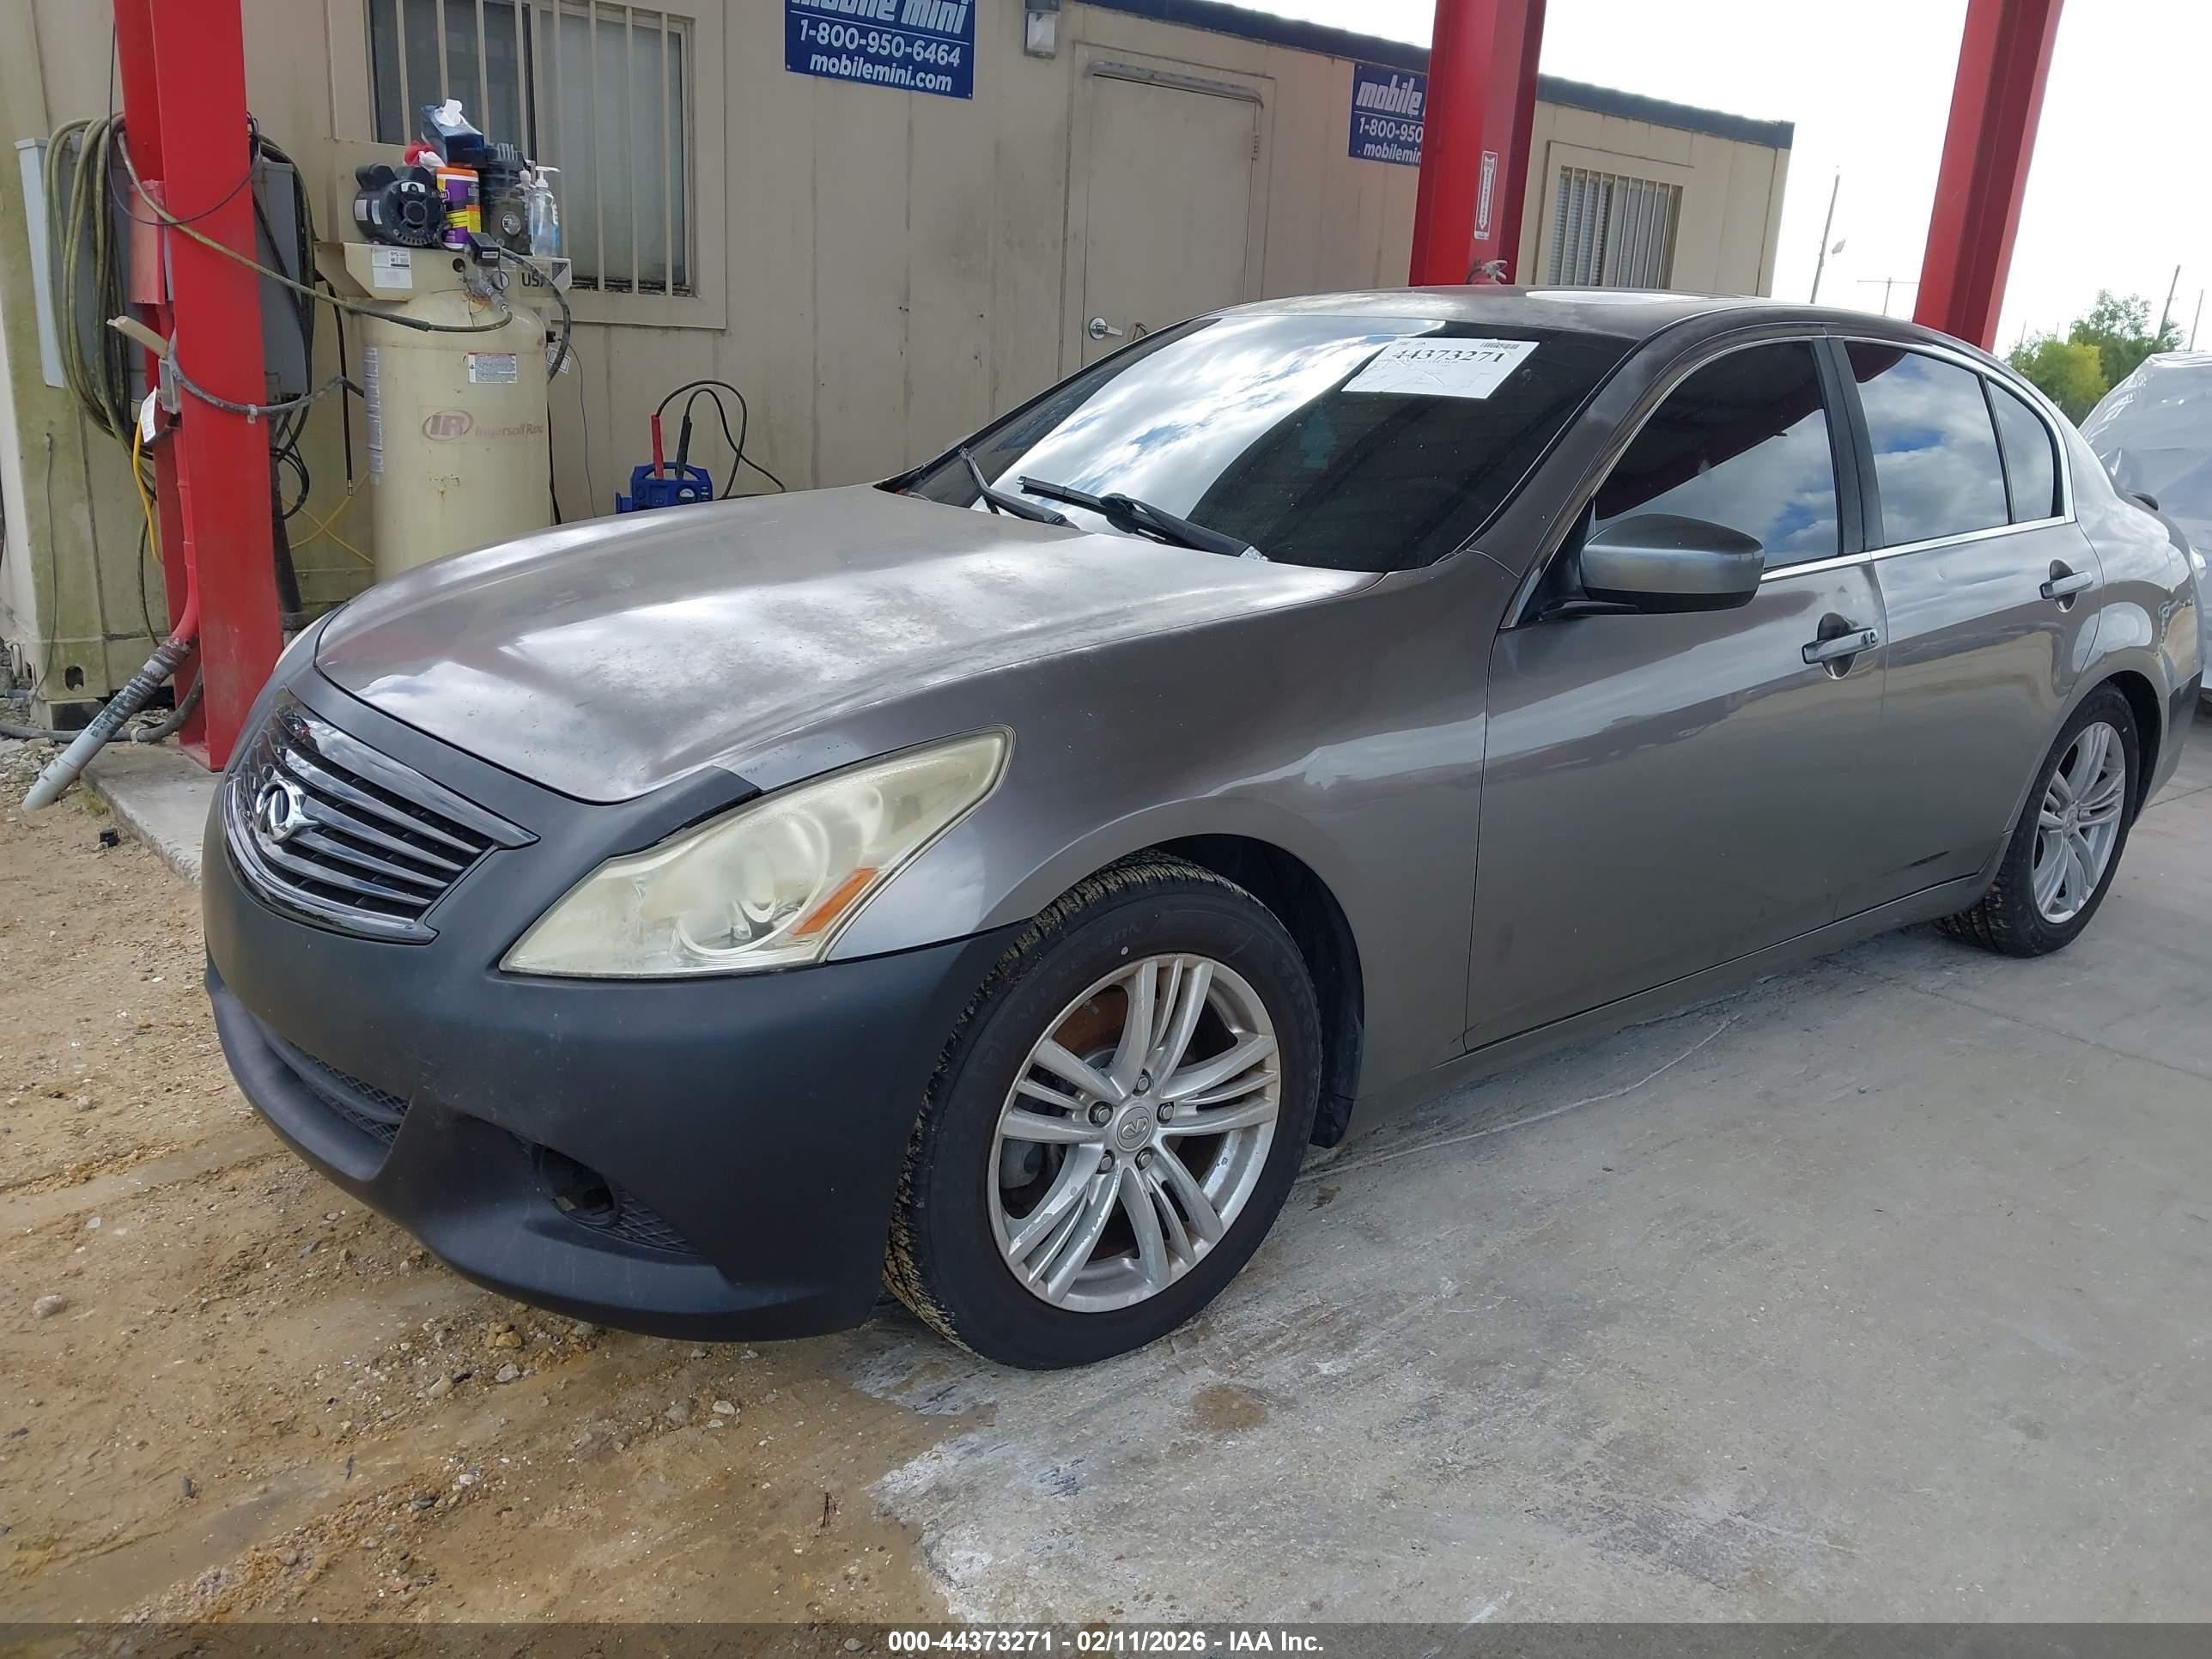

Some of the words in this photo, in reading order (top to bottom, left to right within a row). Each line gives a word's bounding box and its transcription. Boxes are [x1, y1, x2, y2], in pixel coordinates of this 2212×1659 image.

[799, 19, 962, 68] 1-800-950-6464
[809, 53, 952, 92] mobilemini.com
[1356, 75, 1422, 116] mobile
[1359, 117, 1423, 143] 1-800-950
[521, 272, 544, 288] US
[1392, 349, 1505, 363] 44373271
